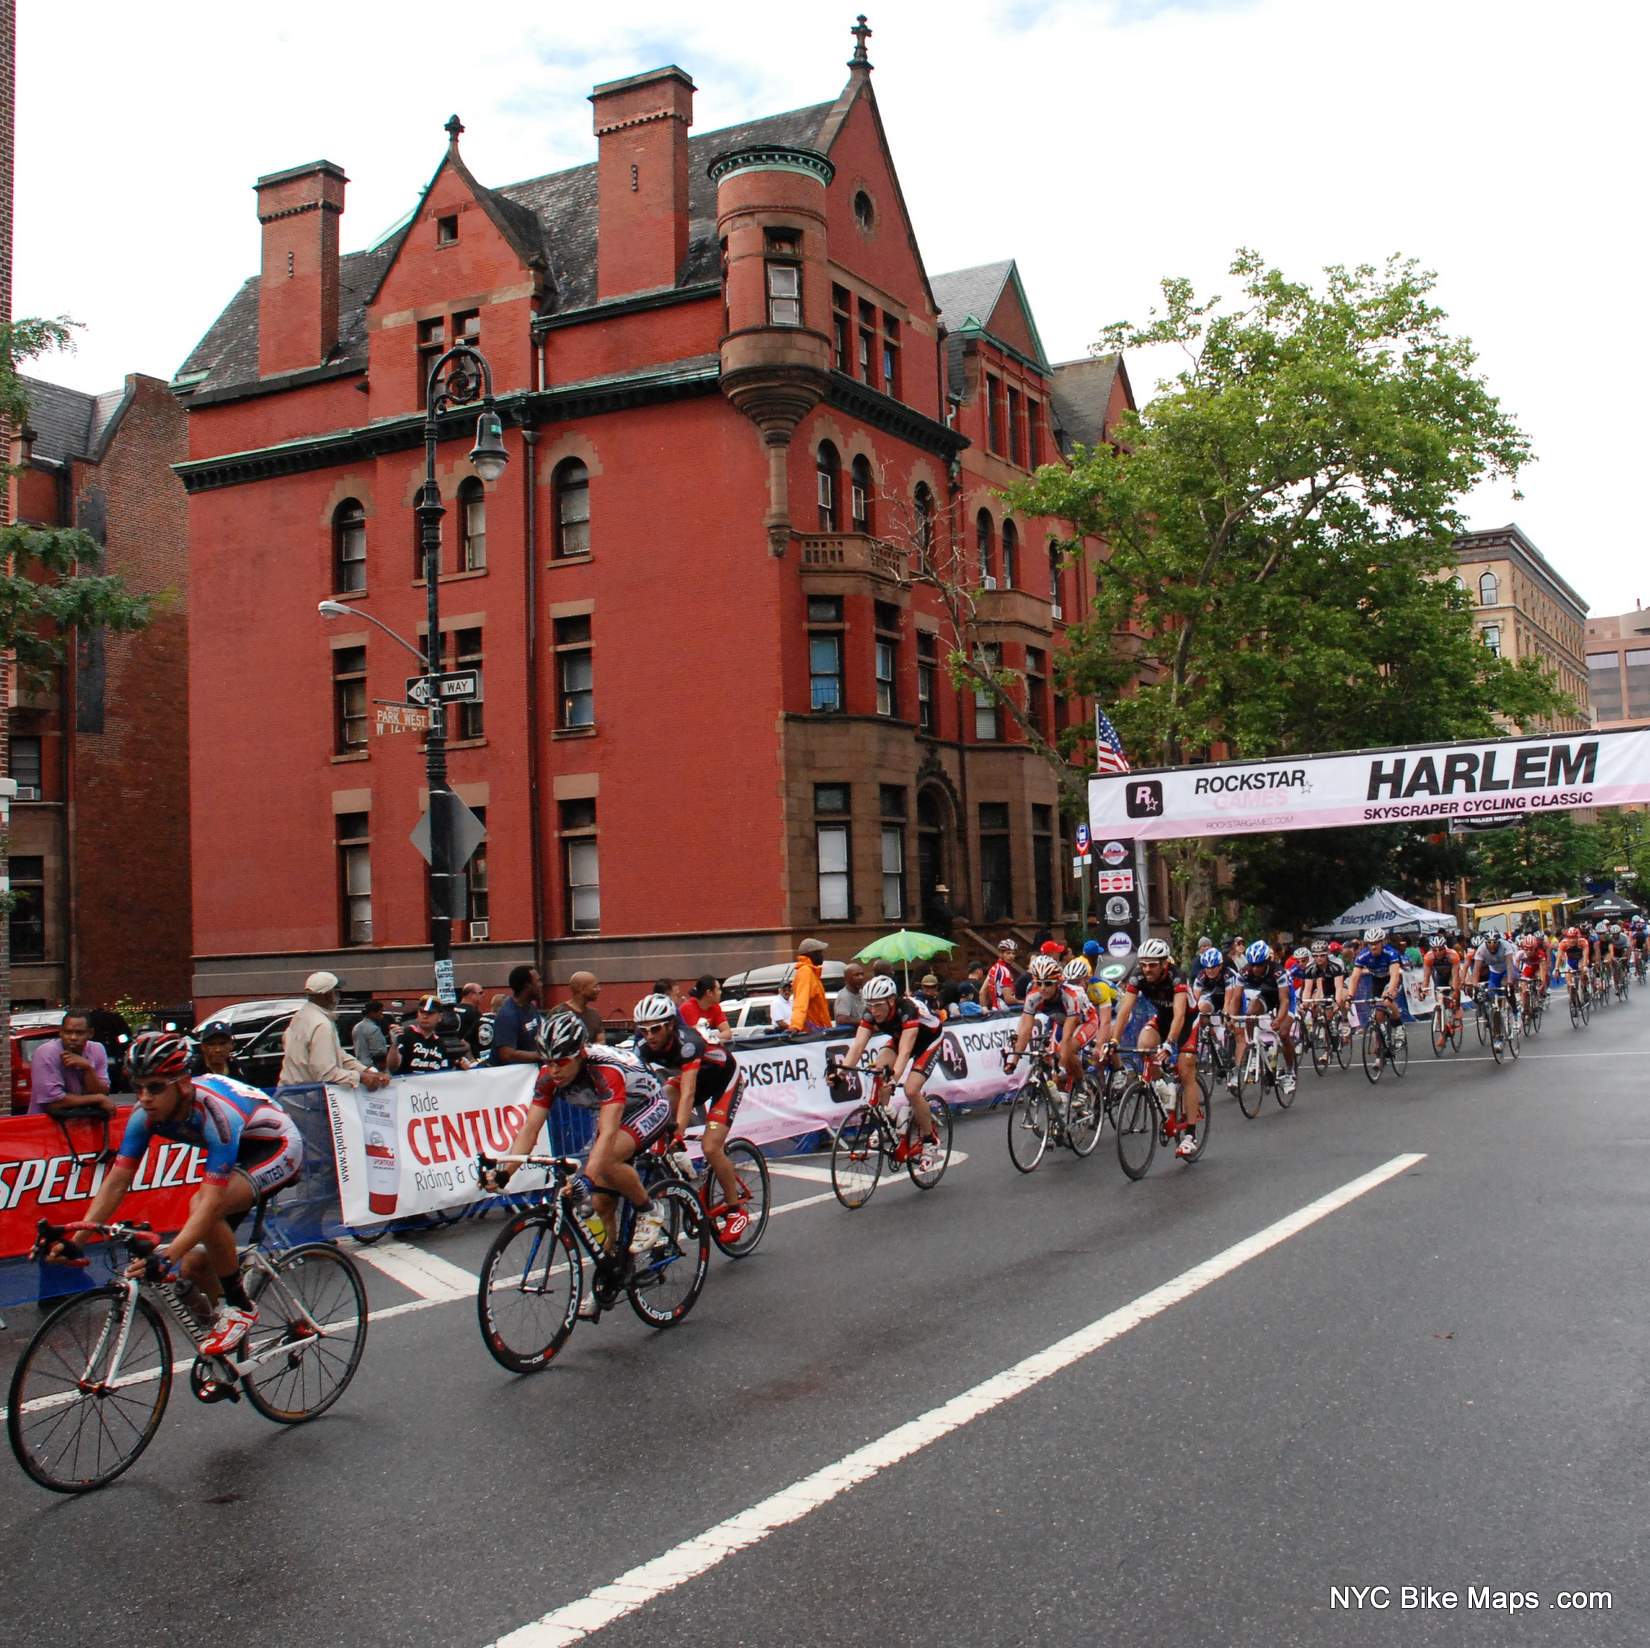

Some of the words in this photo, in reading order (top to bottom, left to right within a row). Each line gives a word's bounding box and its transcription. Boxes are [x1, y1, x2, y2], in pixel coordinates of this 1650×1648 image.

[415, 686, 428, 697] ON
[446, 681, 468, 693] WAY
[377, 710, 400, 724] PARK
[404, 713, 426, 727] WEST
[1195, 769, 1306, 795] ROCKSTAR
[1367, 742, 1599, 801] HARLEM
[1214, 788, 1289, 810] GAMES
[1364, 802, 1458, 820] SKYSCRAPER
[1464, 797, 1526, 813] CYCLING
[1531, 791, 1593, 807] CLASSIC
[1206, 815, 1295, 830] ROCKSTARGAMES.COM
[1340, 910, 1397, 926] Bicycling
[739, 1057, 809, 1089] CKSTAR
[411, 1092, 439, 1113] Ride
[0, 1142, 207, 1210] SPECILIZE
[415, 1169, 454, 1192] Riding
[455, 1165, 466, 1184] &
[666, 1186, 704, 1220] EASTON
[634, 1288, 673, 1321] EASTON
